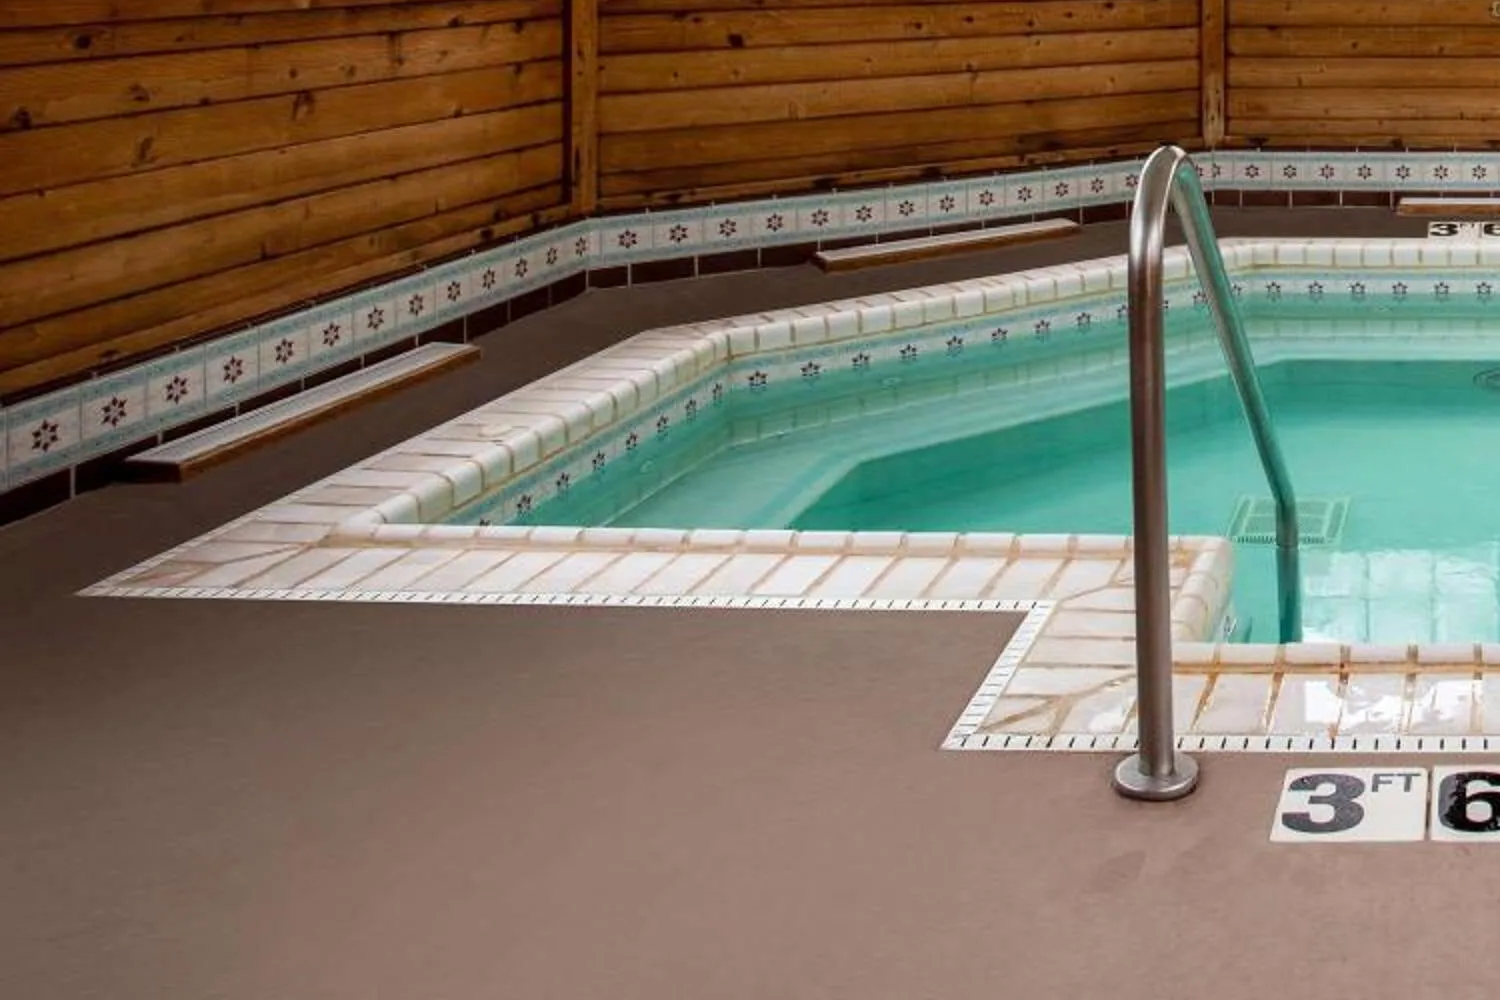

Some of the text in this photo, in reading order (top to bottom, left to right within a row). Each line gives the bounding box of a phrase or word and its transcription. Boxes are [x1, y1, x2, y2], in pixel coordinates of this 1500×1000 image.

[1430, 223, 1459, 237] 3
[1281, 772, 1365, 834] 3
[1371, 773, 1422, 793] FT
